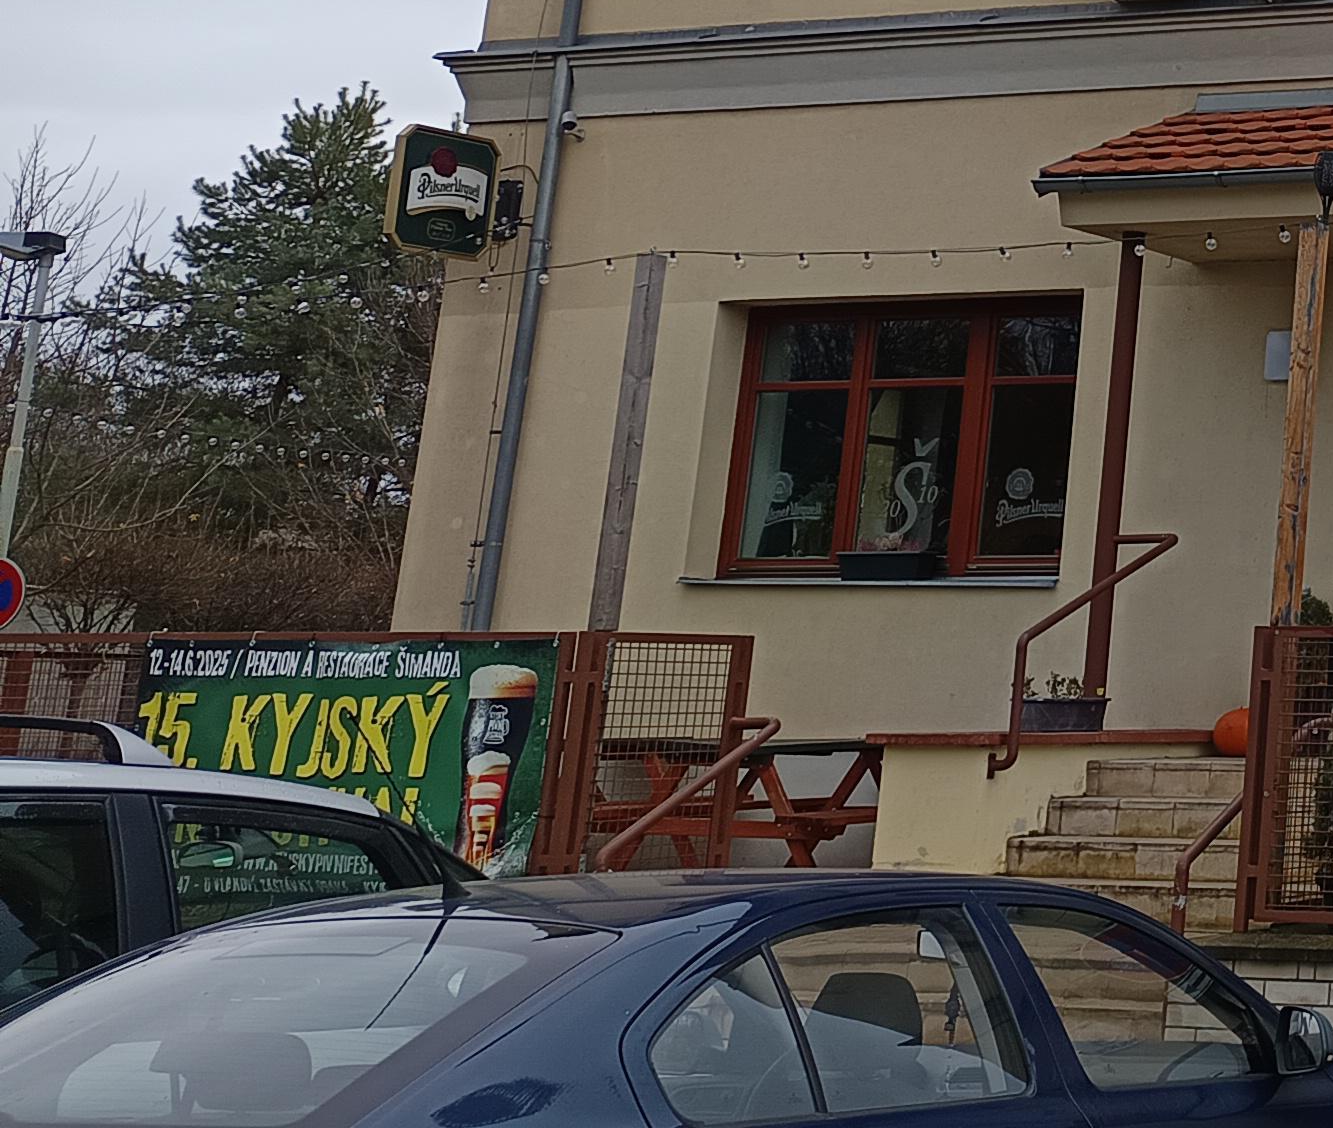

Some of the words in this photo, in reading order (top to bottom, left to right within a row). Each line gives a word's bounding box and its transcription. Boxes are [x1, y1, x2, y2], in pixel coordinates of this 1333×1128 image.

[416, 172, 455, 200] Pilsner
[454, 176, 481, 202] Urquell
[149, 648, 232, 677] 12-14.6.2025
[244, 650, 302, 678] PENZION
[316, 650, 392, 679] RESTAURACE
[395, 646, 461, 678] ŠIMANDA
[138, 691, 198, 769] 15.
[219, 681, 450, 779] KYJSKÝ
